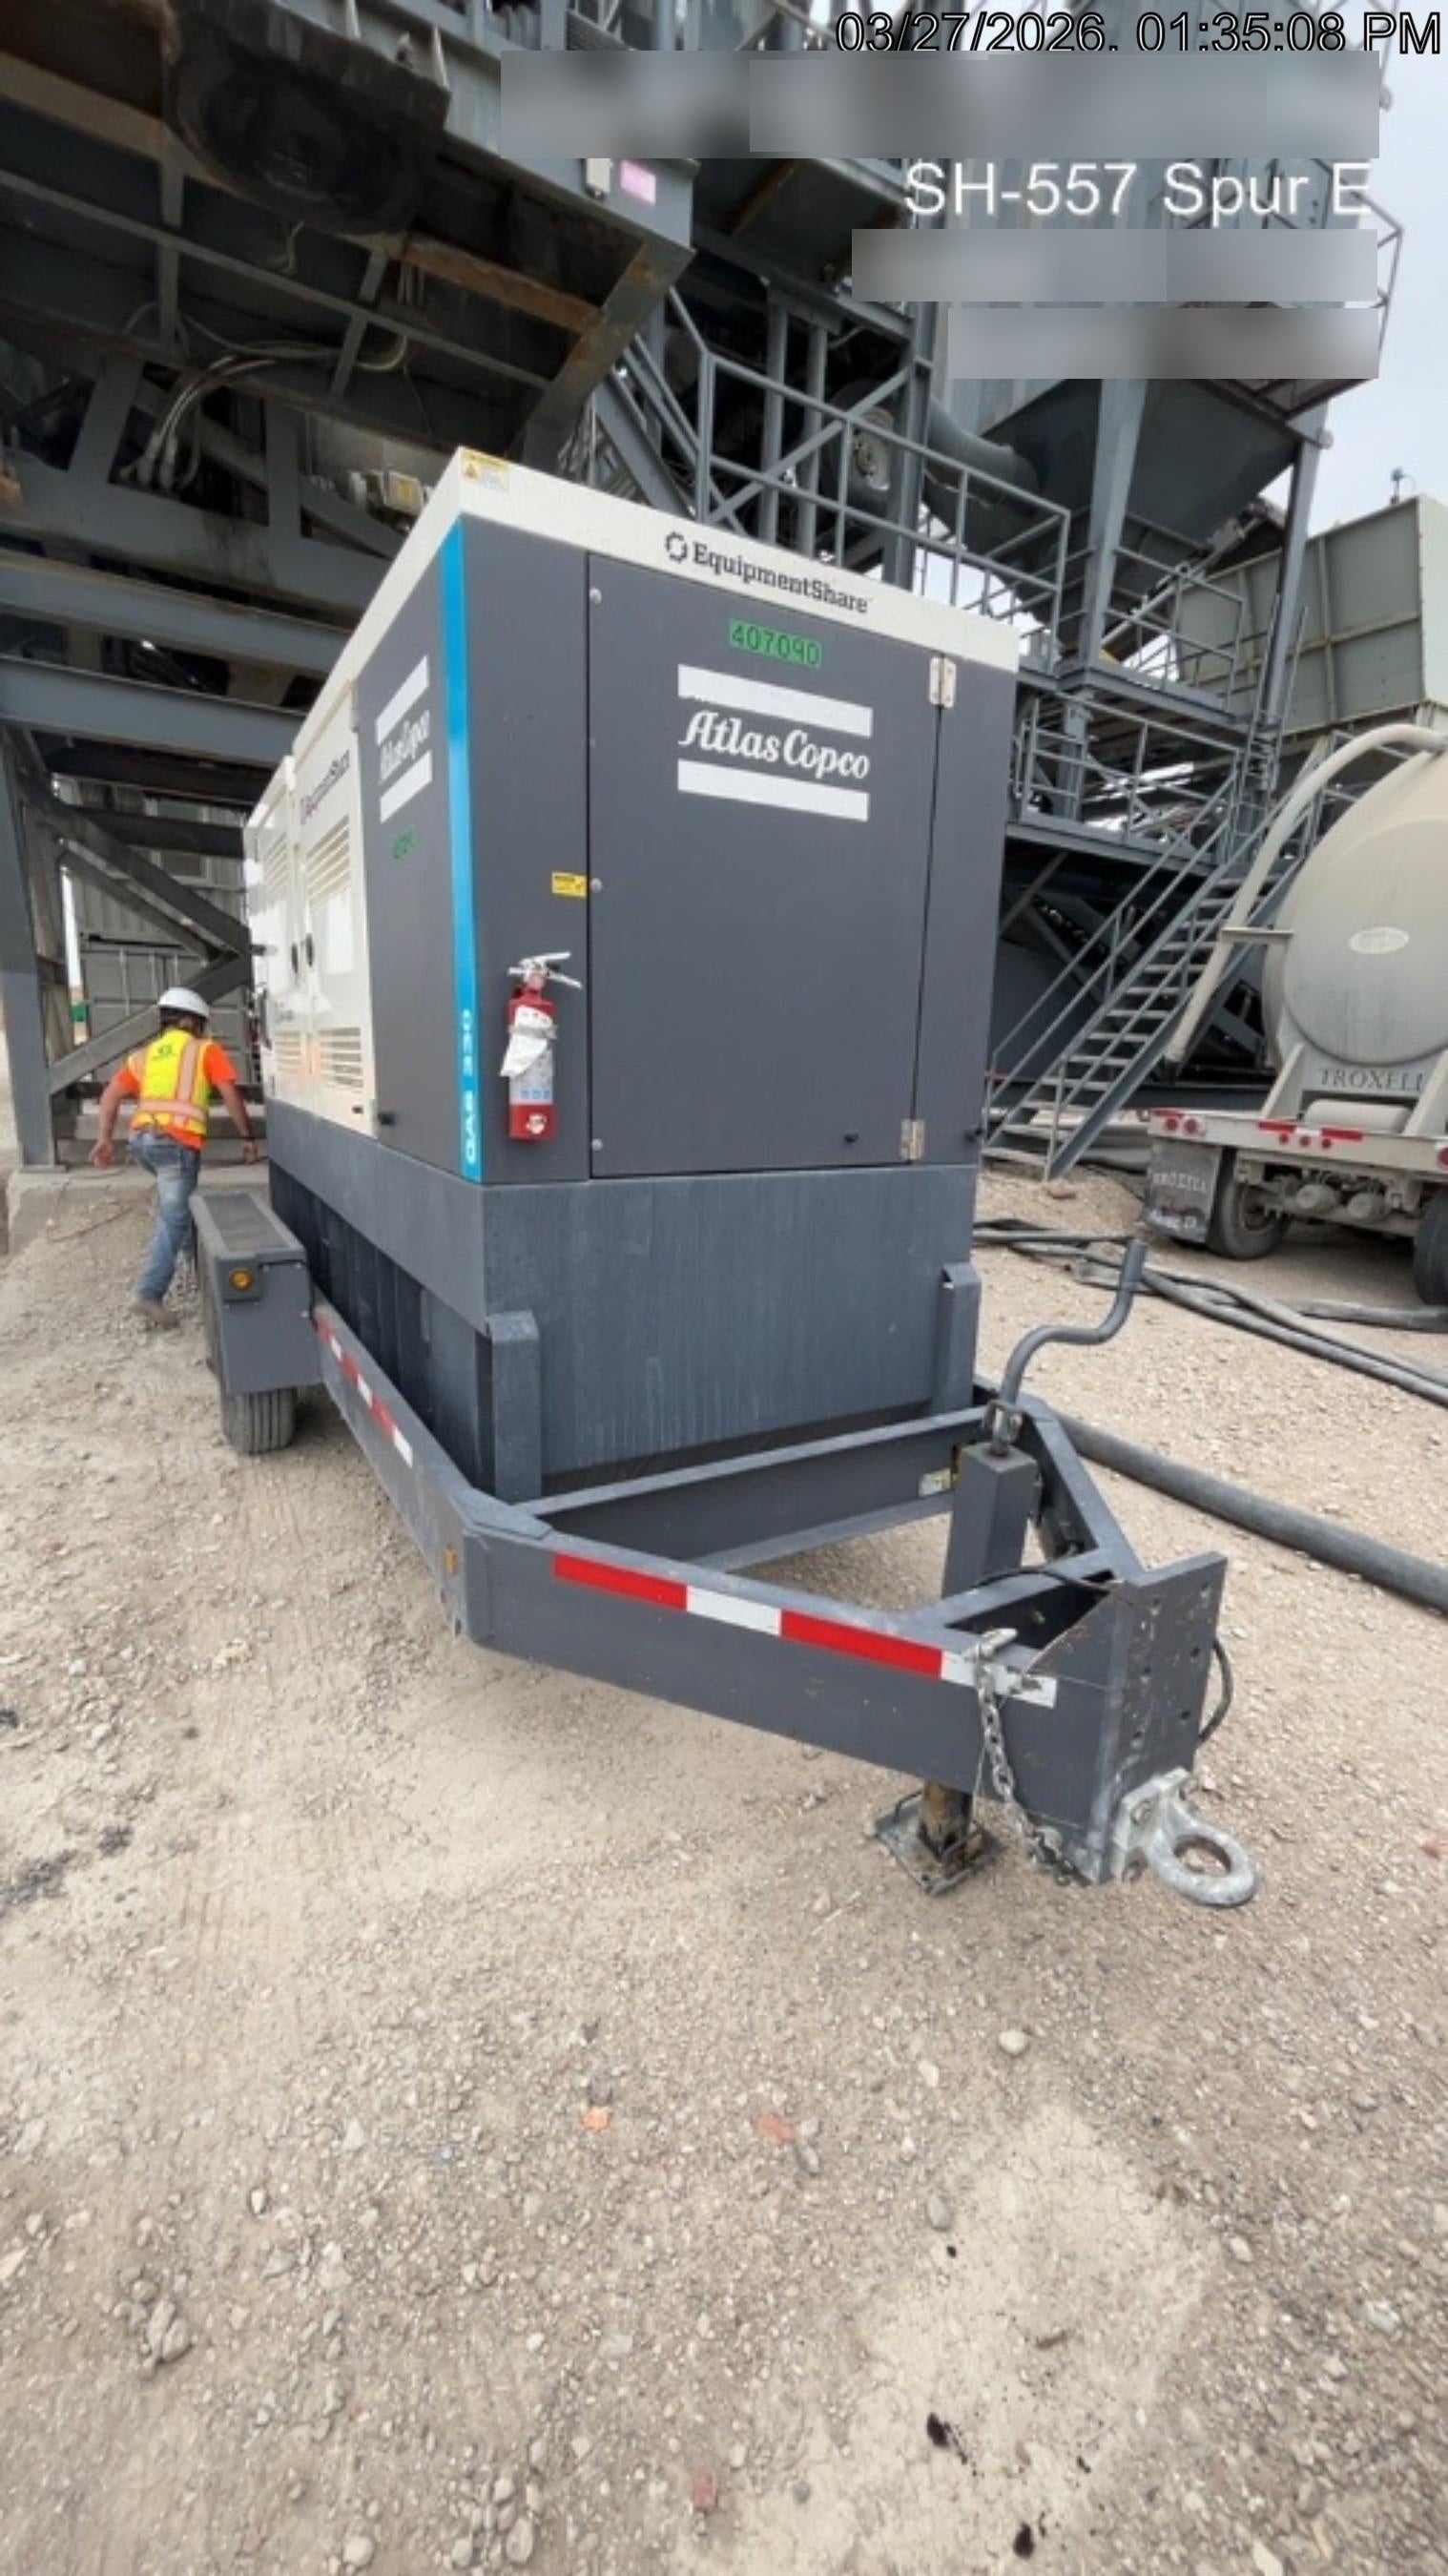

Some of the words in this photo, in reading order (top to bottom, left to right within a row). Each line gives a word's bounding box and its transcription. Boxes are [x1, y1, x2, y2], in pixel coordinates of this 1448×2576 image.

[692, 540, 869, 613] EquipmentShare
[731, 625, 820, 666] 407090
[677, 709, 781, 762] Atlas
[783, 729, 870, 779] Copco
